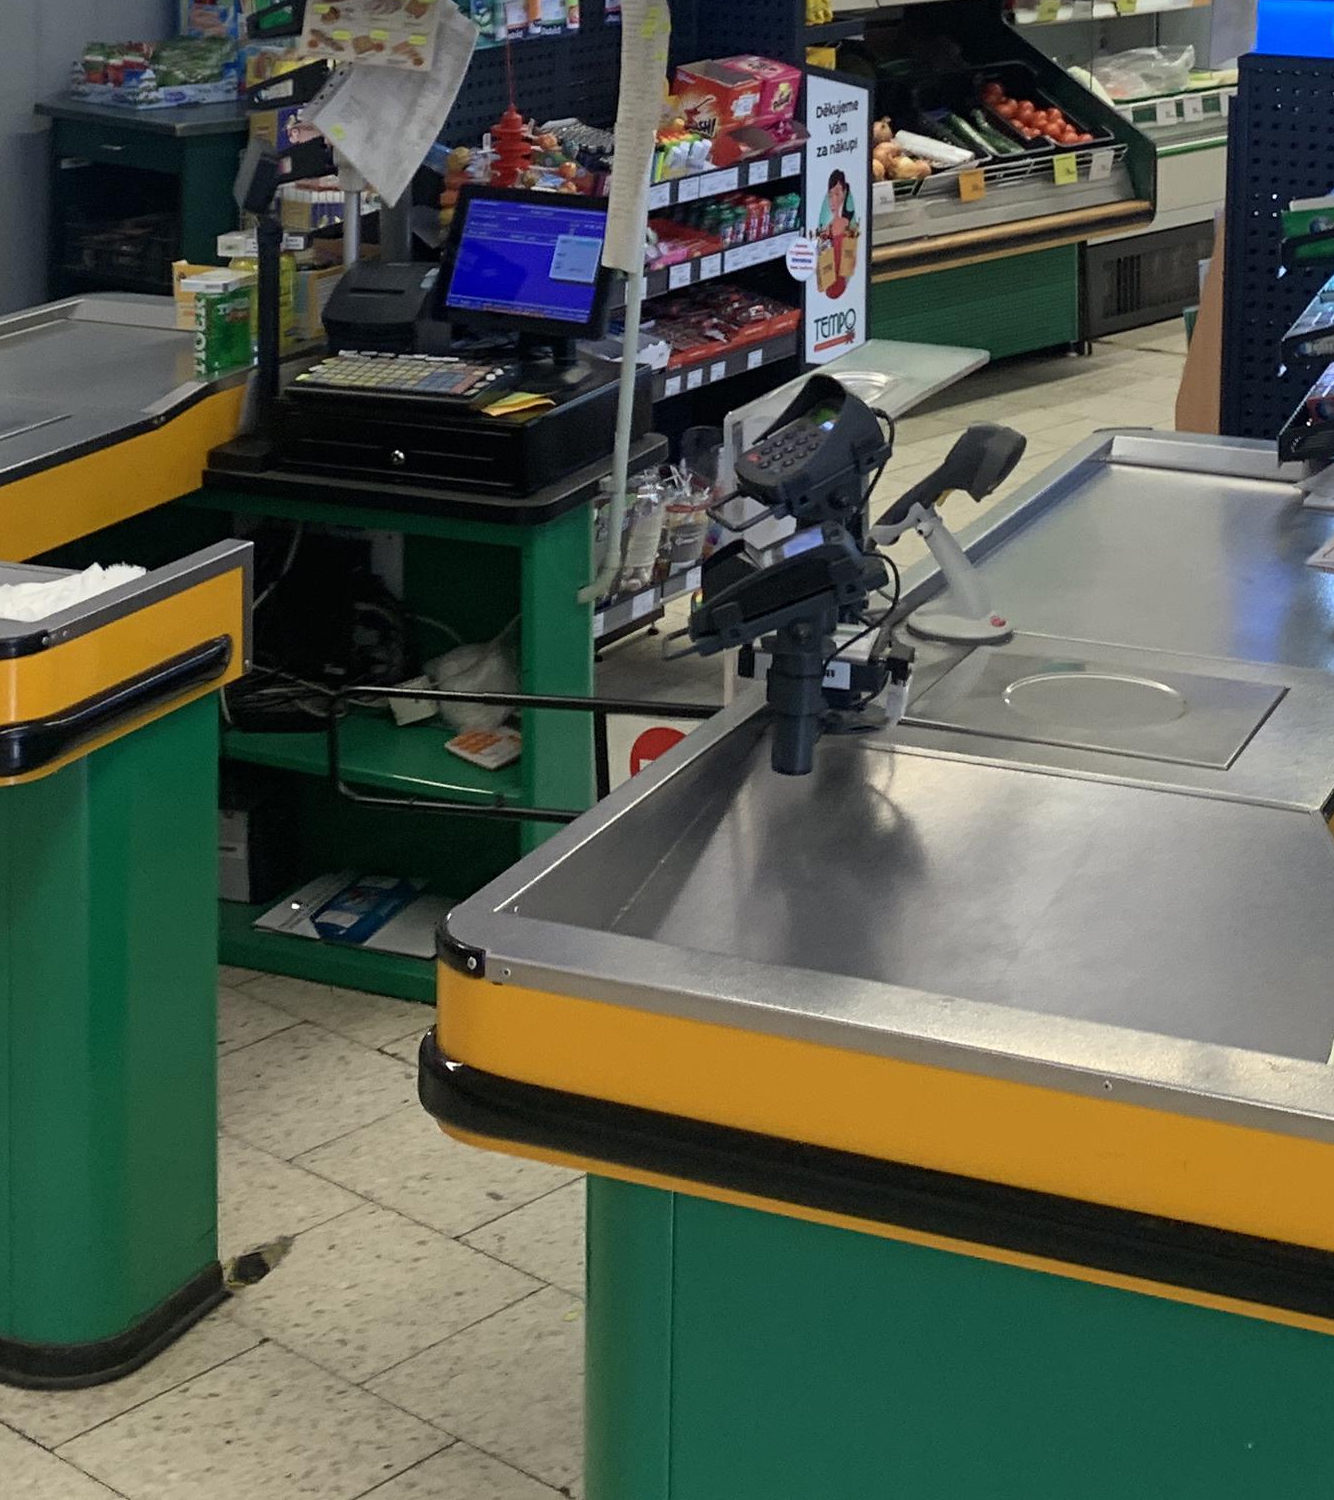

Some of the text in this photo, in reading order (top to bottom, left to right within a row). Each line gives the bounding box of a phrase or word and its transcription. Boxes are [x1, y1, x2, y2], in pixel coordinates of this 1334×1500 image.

[816, 98, 859, 120] Děkujeme
[816, 145, 828, 157] za
[813, 308, 857, 342] TEMPO
